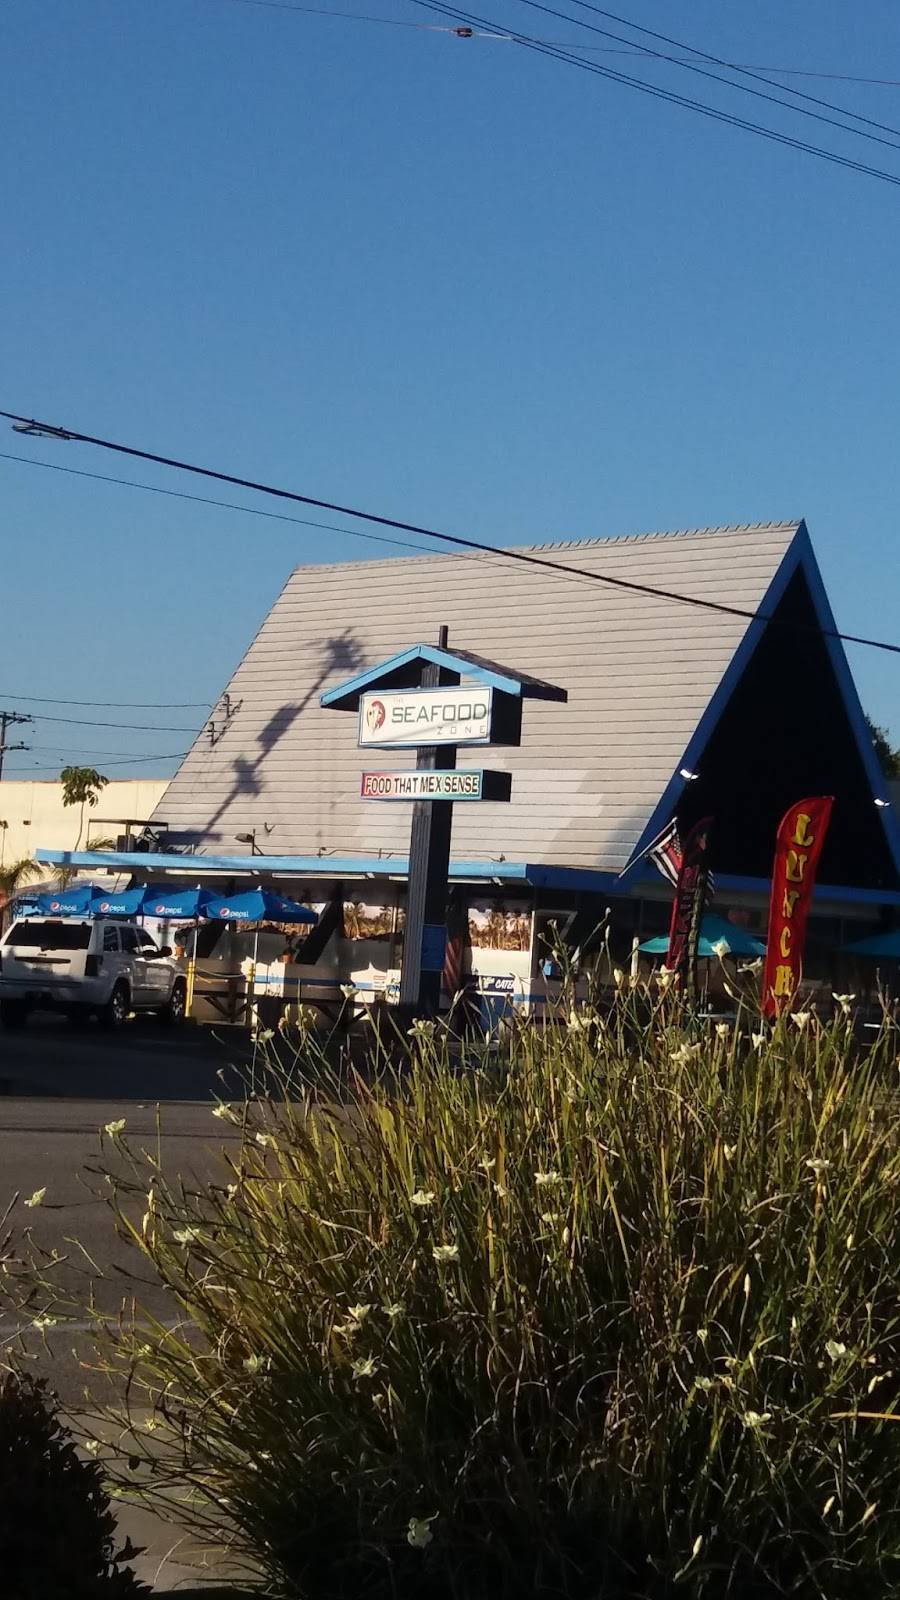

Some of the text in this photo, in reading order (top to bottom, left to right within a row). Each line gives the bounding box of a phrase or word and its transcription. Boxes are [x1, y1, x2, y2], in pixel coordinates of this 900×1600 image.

[392, 703, 487, 723] SEAFOOD
[437, 725, 486, 735] ZONE
[366, 776, 478, 793] FOOD THAT MEX SENSE
[60, 904, 77, 912] pepsi
[109, 904, 126, 913] pepsi
[774, 813, 815, 997] LUNCH
[165, 907, 182, 915] pepsi
[230, 910, 249, 919] pepsi
